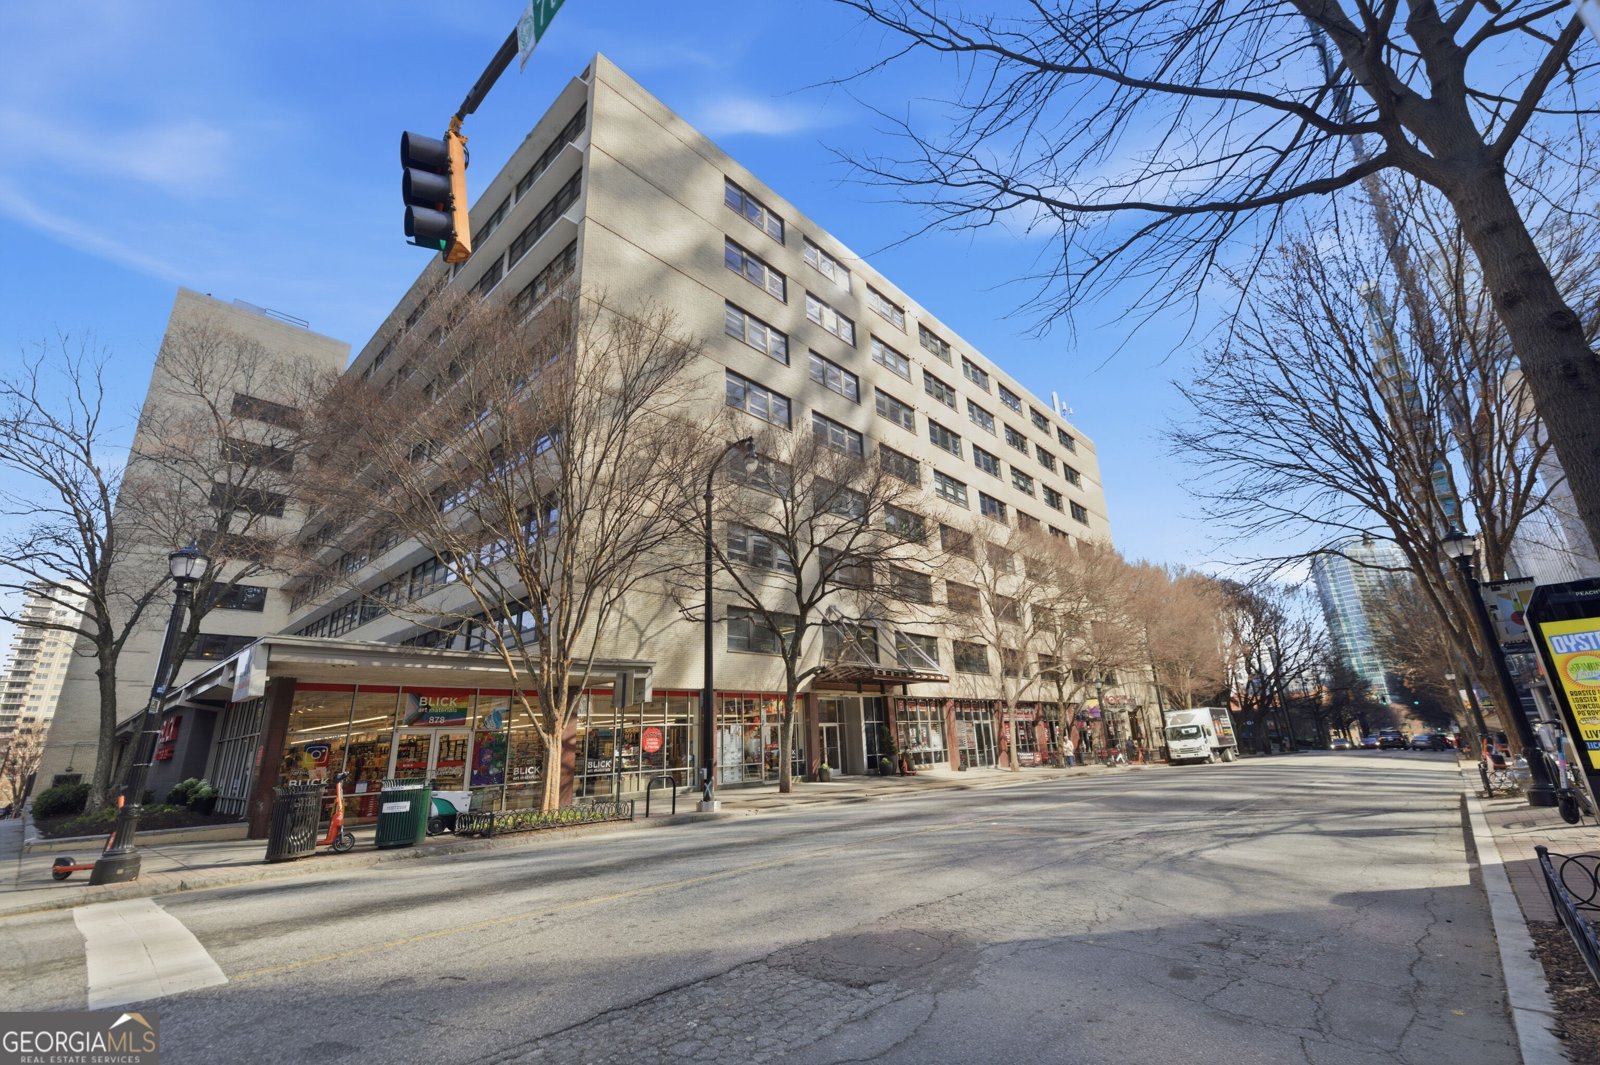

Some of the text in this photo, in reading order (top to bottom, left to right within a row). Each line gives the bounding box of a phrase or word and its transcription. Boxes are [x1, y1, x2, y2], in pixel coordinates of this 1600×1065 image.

[1575, 588, 1600, 597] PEACH
[1569, 689, 1597, 697] ROASTED
[419, 696, 458, 707] BLICK
[1572, 696, 1598, 704] LOBSTER
[428, 716, 446, 724] 878
[588, 760, 612, 769] BLICK
[513, 765, 541, 776] BLICK
